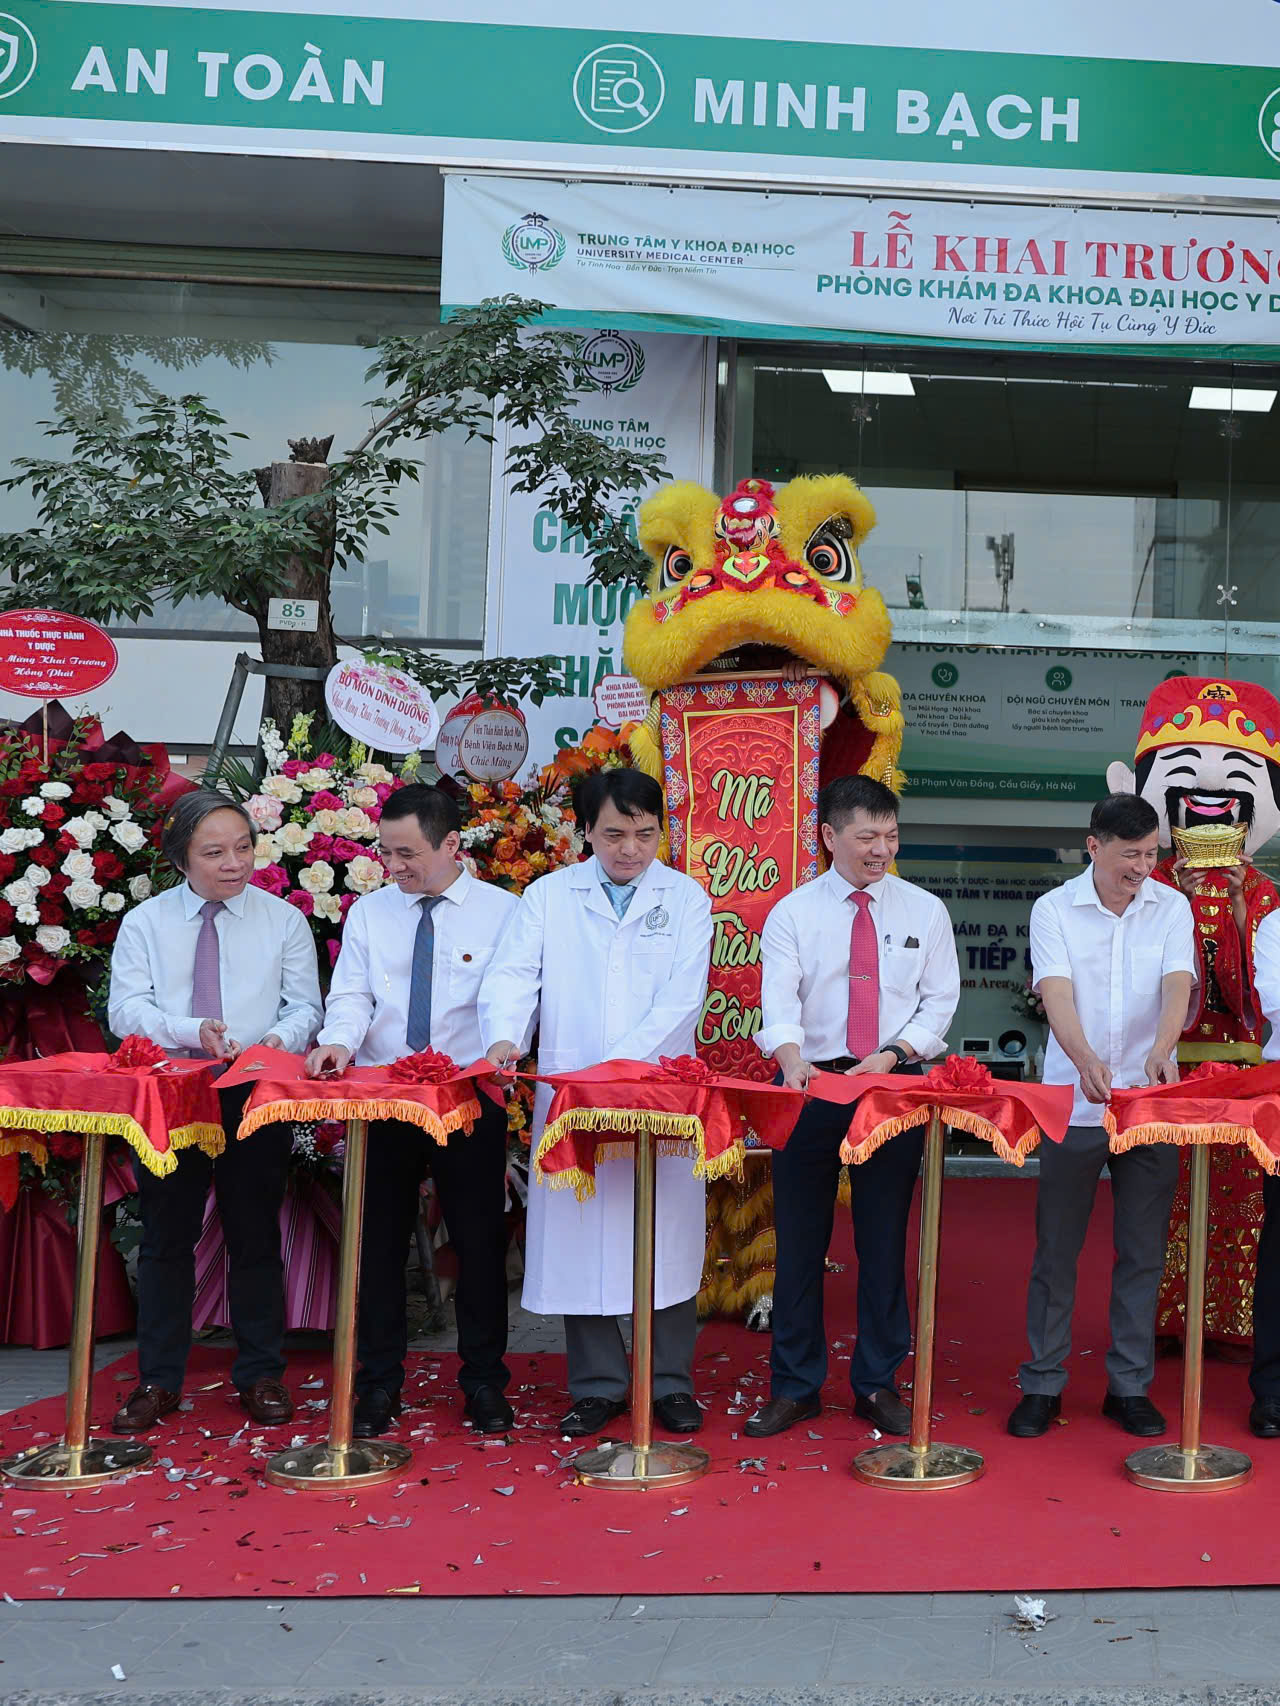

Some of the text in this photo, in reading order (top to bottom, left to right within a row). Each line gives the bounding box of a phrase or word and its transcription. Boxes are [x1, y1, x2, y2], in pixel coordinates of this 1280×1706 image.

[71, 42, 386, 106] AN TOÀN
[693, 78, 1080, 150] MINH BẠCH
[577, 233, 795, 259] TRUNG TÂM Y KHOA ĐẠI HỌC
[850, 211, 913, 269] LỄ
[932, 234, 1069, 276] KHAI
[577, 248, 744, 265] UNIVERSITY MEDICAL CENTER
[817, 270, 912, 297] PHÒNG
[919, 275, 996, 300] KHÁM
[1003, 283, 1041, 302] ĐA
[1050, 284, 1122, 306] KHOA
[1129, 288, 1174, 313] ĐẠI
[1182, 289, 1238, 316] HỌC
[1245, 292, 1262, 312] Y
[948, 307, 977, 326] Nơi
[1012, 309, 1050, 328] Thức
[1056, 311, 1085, 332] Hội
[1091, 313, 1112, 334] Tụ
[1117, 314, 1158, 336] Cùng
[1163, 316, 1179, 335] Y
[1185, 316, 1217, 335] Đức
[571, 418, 649, 432] RUNG TÂM
[634, 436, 666, 451] HỌC
[281, 603, 305, 618] 85
[15, 628, 40, 638] THUỐC
[63, 630, 85, 640] HÀNH
[28, 642, 34, 650] Y
[902, 692, 986, 703] ĐA CHUYÊN KHOA
[1007, 694, 1110, 707] ĐỘI NGŨ CHUYÊN MÔN
[513, 742, 525, 751] Mai
[922, 778, 948, 788] Phạm
[949, 778, 968, 787] Văn
[970, 777, 997, 789] Đồng,
[999, 778, 1018, 789] Cầu
[1046, 781, 1058, 790] Hà
[1060, 781, 1076, 791] Nội
[711, 768, 775, 830] Mã
[703, 841, 780, 897] Đáo
[956, 887, 982, 899] TÂM
[983, 889, 990, 899] Y
[993, 889, 1023, 900] KHOA
[987, 924, 1008, 937] ĐA
[711, 910, 763, 968] Thàn
[966, 938, 1017, 971] TIẾP
